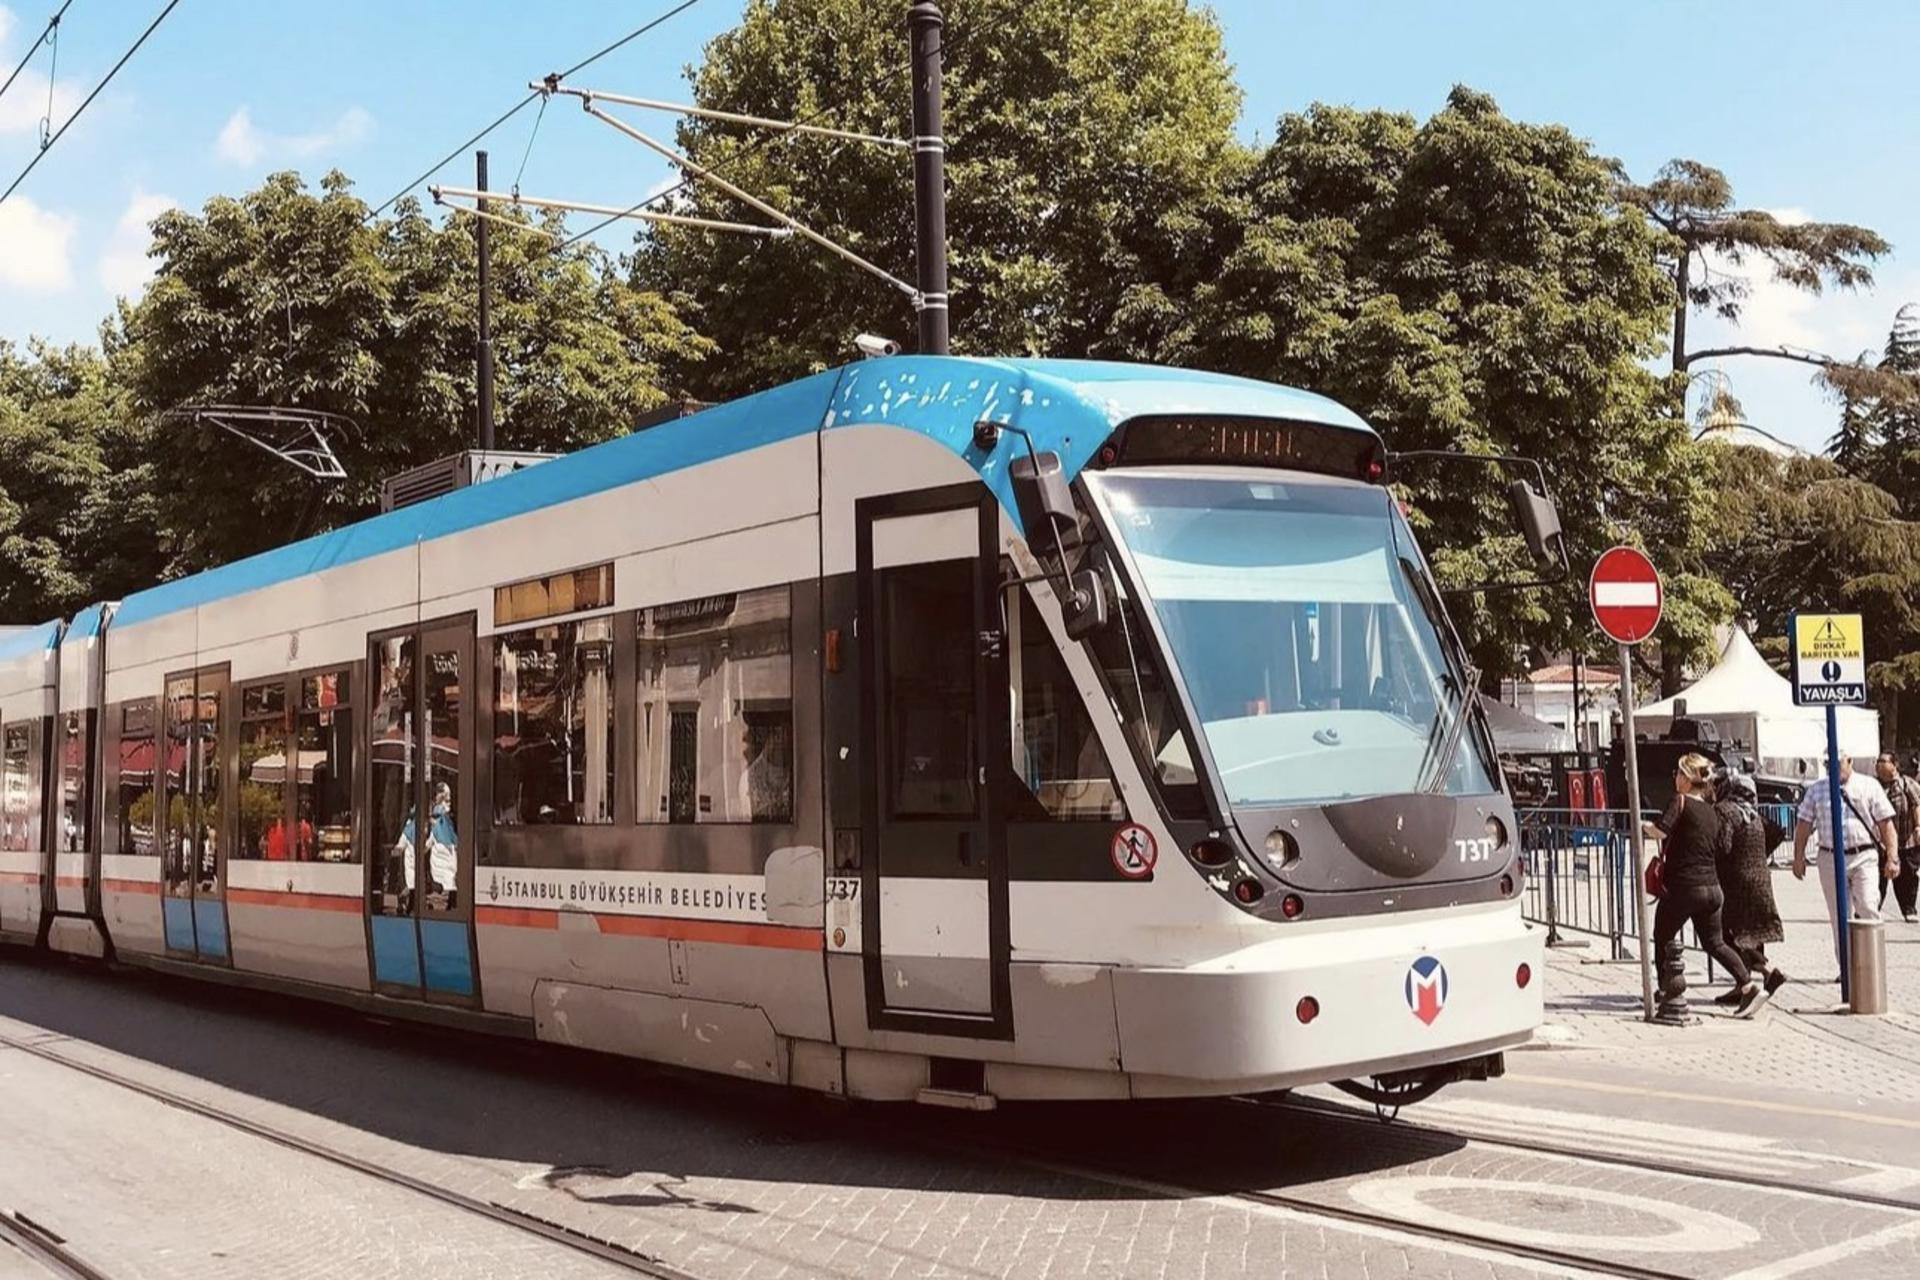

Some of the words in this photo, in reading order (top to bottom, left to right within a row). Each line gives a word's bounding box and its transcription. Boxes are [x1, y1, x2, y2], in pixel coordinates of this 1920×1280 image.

[1842, 650, 1859, 658] VAR
[1803, 687, 1862, 703] YAVAŞLA
[1455, 838, 1491, 862] 737
[501, 876, 564, 900] İSTANBUL
[570, 880, 662, 908] BÜYÜKŞEHİR
[828, 879, 859, 901] 737
